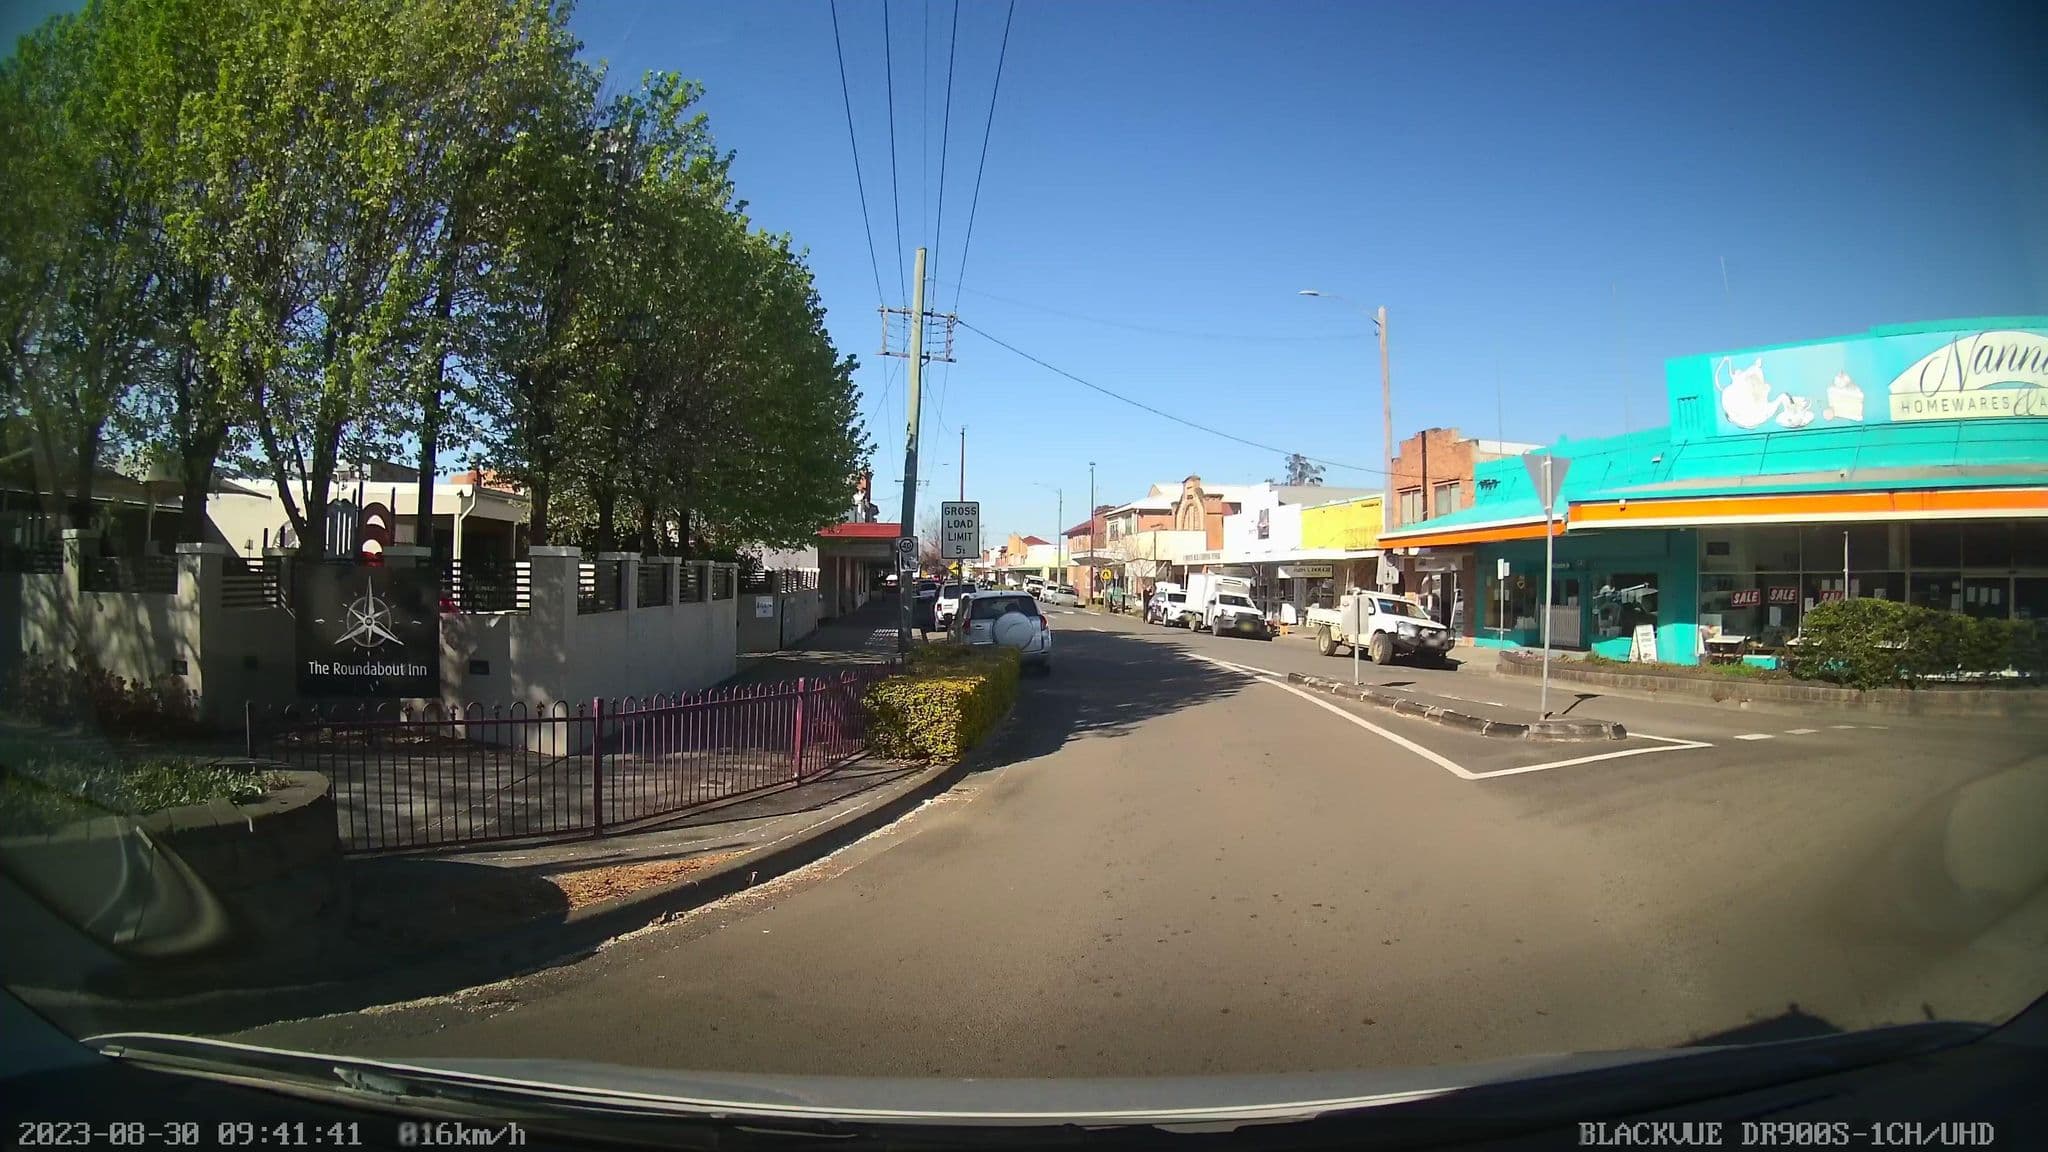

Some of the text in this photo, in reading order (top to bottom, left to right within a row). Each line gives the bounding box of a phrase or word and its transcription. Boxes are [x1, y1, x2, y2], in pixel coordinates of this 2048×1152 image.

[1920, 332, 2048, 398] Nann
[1901, 396, 2009, 414] HOMEWARES
[944, 506, 977, 516] GROSS
[947, 519, 974, 529] LOAD
[948, 532, 973, 542] LIMIT
[901, 541, 912, 550] 40
[1733, 591, 1758, 604] SALE
[1769, 588, 1795, 601] SALE
[1822, 591, 1846, 602] SAL
[308, 660, 428, 676] The Roundabout Inn
